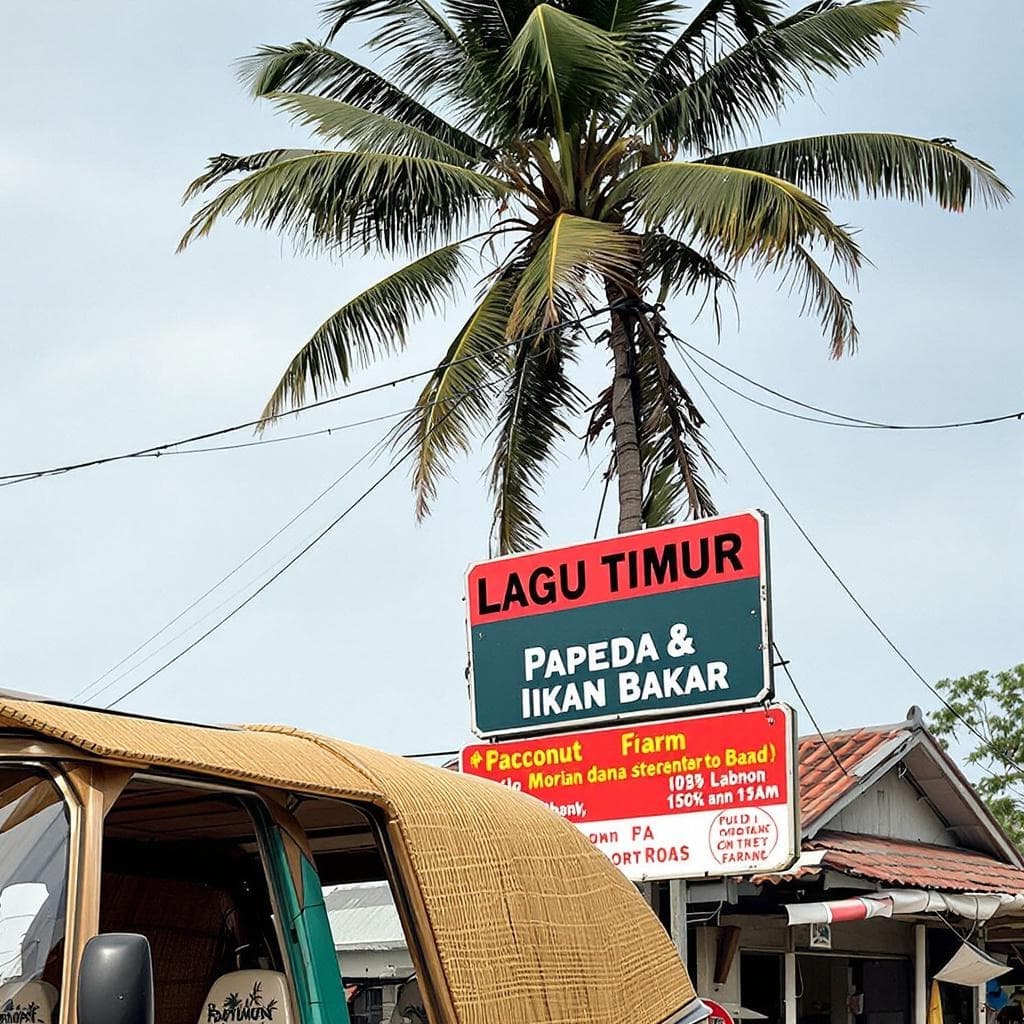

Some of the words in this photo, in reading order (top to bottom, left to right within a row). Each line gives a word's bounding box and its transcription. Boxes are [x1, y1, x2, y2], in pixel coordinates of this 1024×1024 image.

[478, 560, 586, 615] LAGU
[601, 532, 744, 593] TIMUR
[524, 632, 660, 681] PAPEDA
[667, 623, 696, 658] &
[521, 678, 606, 719] IIKAN
[618, 661, 729, 704] BAKAR
[485, 740, 583, 772] Pacconut
[621, 732, 686, 756] Fiarm
[587, 766, 627, 783] dana
[632, 825, 654, 841] PA
[645, 845, 689, 863] ROAS
